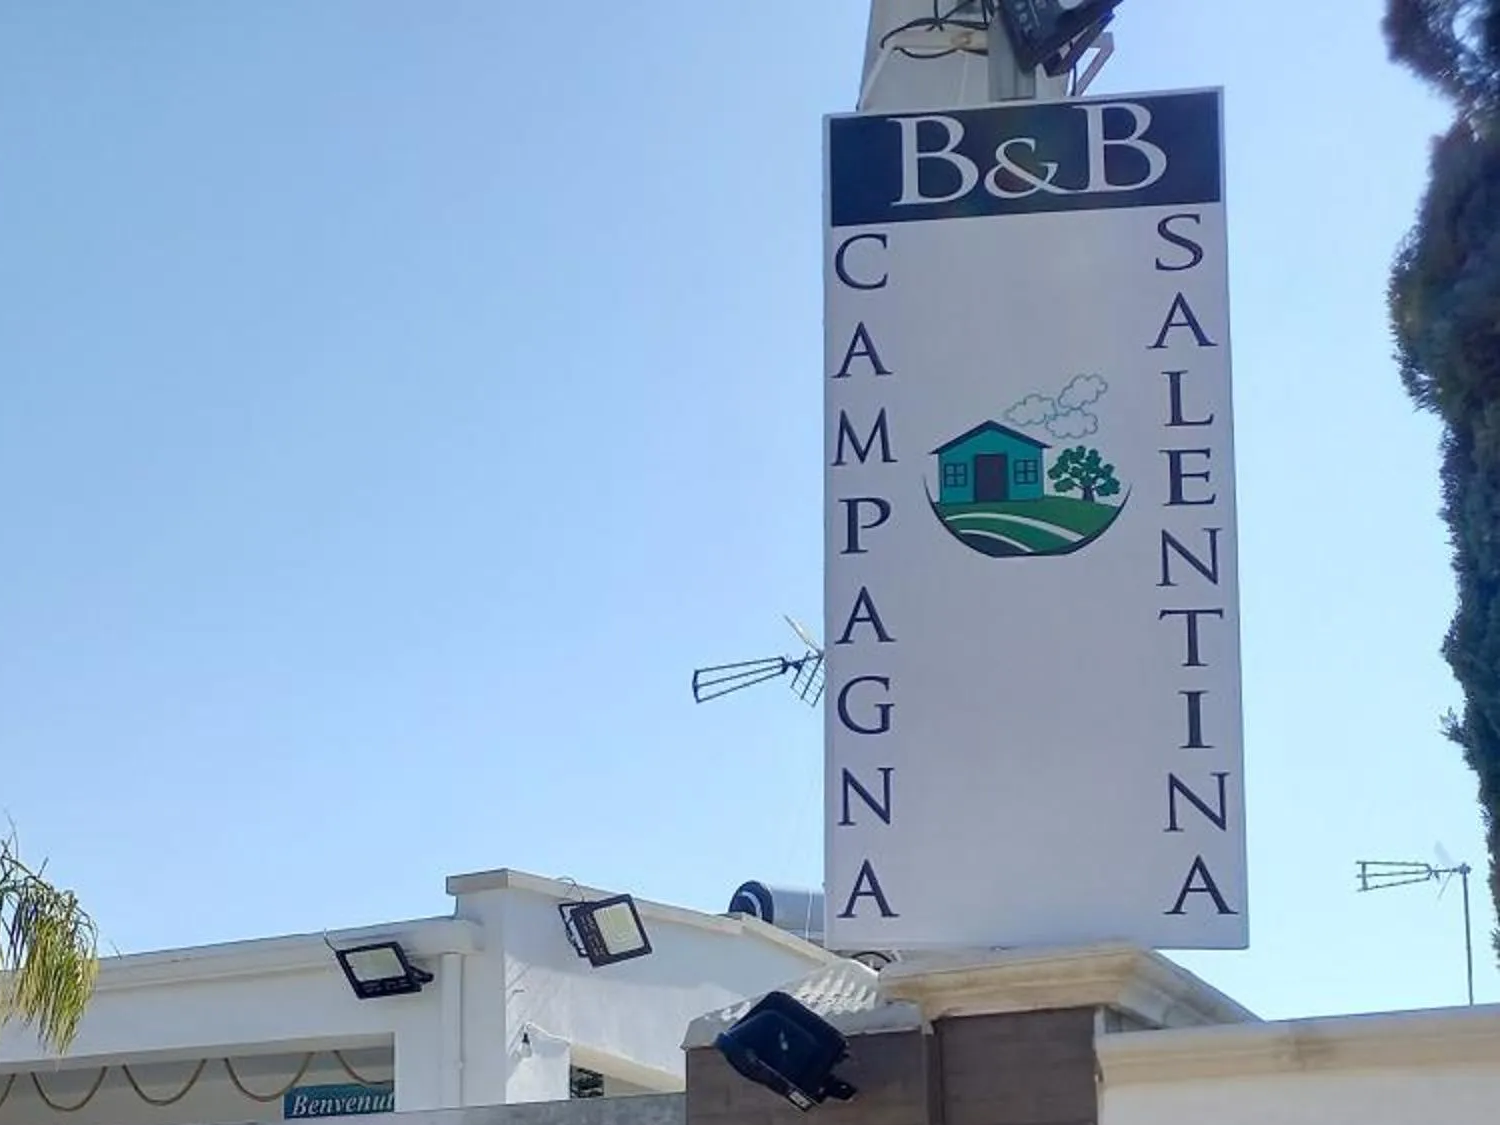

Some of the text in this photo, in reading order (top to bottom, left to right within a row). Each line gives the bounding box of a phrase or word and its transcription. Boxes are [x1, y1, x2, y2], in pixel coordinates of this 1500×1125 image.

[891, 101, 1168, 207] B&B
[832, 232, 900, 920] CAMPAGNA
[1147, 211, 1238, 917] SALENTINA
